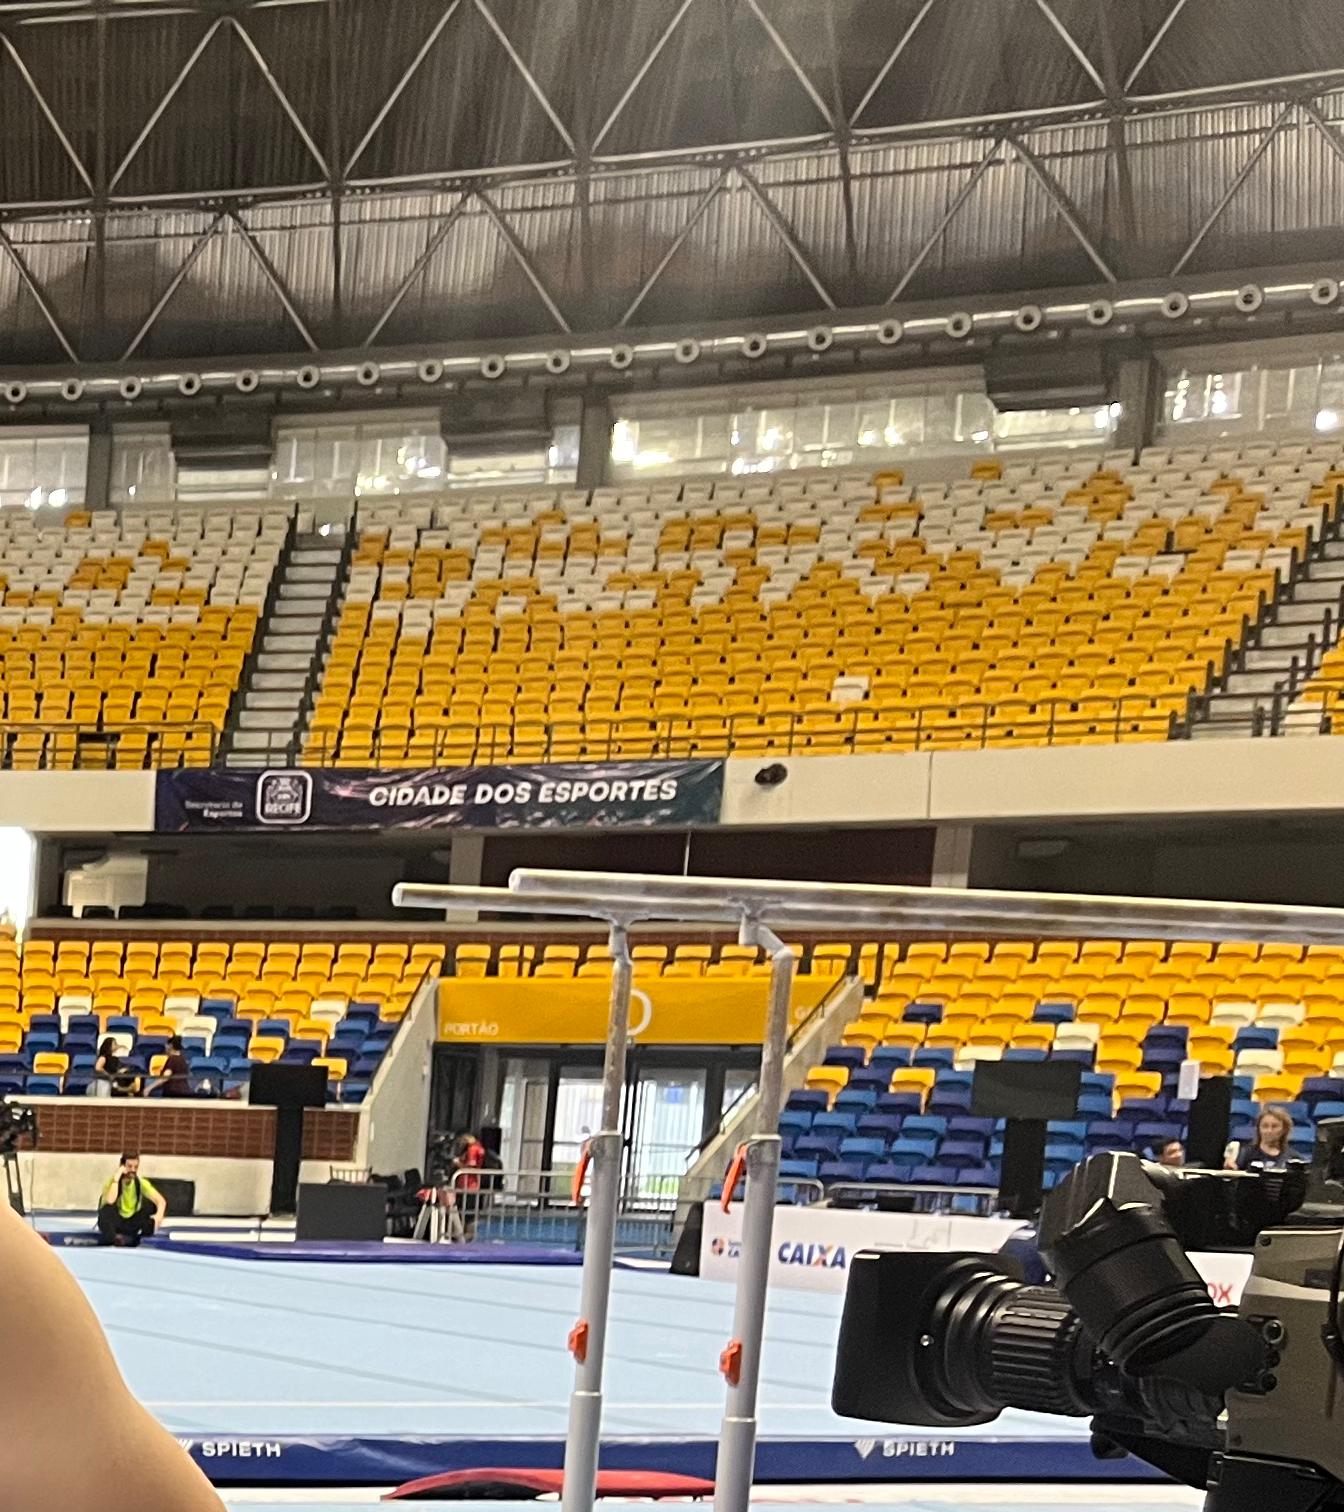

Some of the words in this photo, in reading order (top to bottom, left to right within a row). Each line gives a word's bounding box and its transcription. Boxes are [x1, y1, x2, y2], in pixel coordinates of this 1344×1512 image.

[369, 783, 467, 806] CIDADE
[474, 781, 532, 805] DOS
[538, 779, 678, 803] ESPORTES
[778, 1242, 846, 1269] CAIXA
[202, 1441, 281, 1457] SPIETH
[883, 1440, 955, 1457] SPIETH
